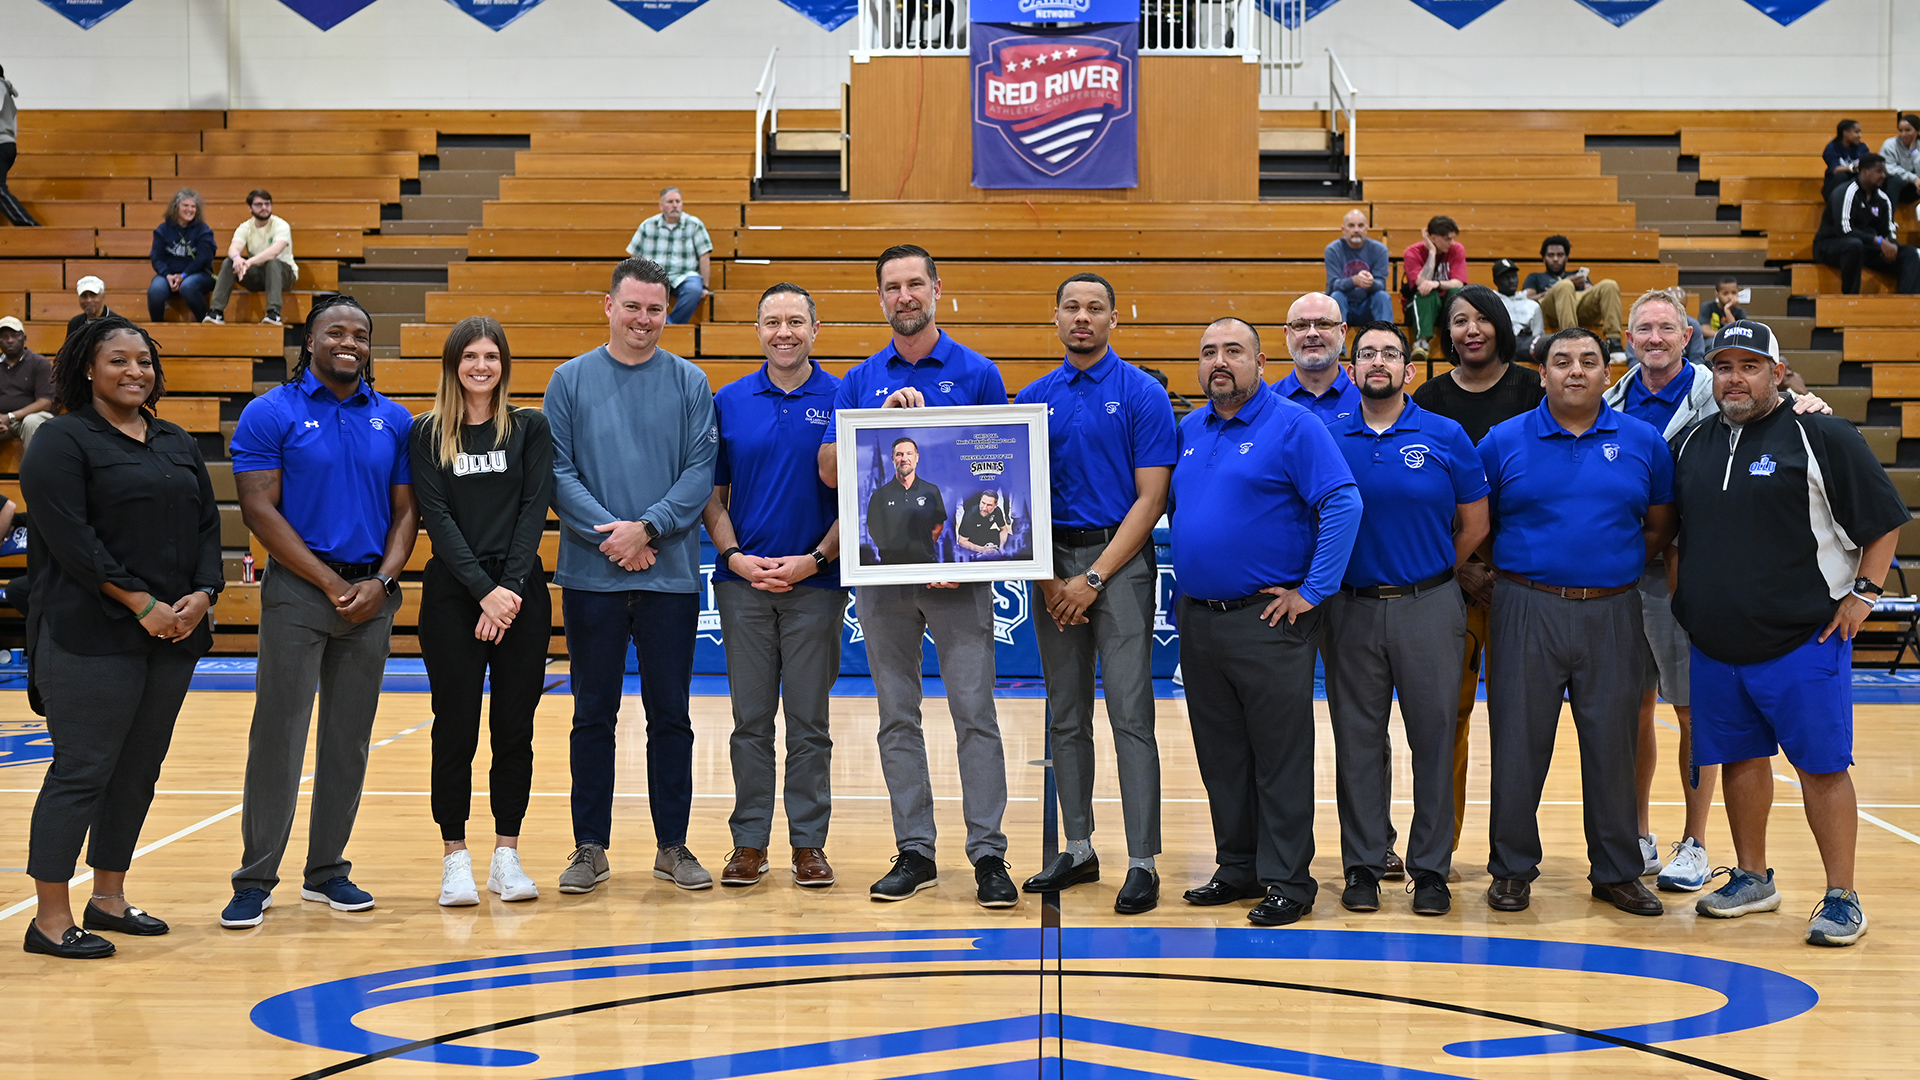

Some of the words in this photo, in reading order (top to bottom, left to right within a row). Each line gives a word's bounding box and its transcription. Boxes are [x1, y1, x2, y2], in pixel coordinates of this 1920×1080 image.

[1035, 9, 1076, 18] NETWORK
[988, 79, 1038, 106] RED
[1045, 65, 1119, 99] RIVER
[989, 102, 1041, 116] ATHLETIC
[1045, 90, 1119, 109] CONFERENCE
[1724, 327, 1753, 338] SAINTS
[453, 450, 507, 477] OLLU
[970, 461, 1005, 474] SAINTS
[1749, 461, 1777, 473] OLLU
